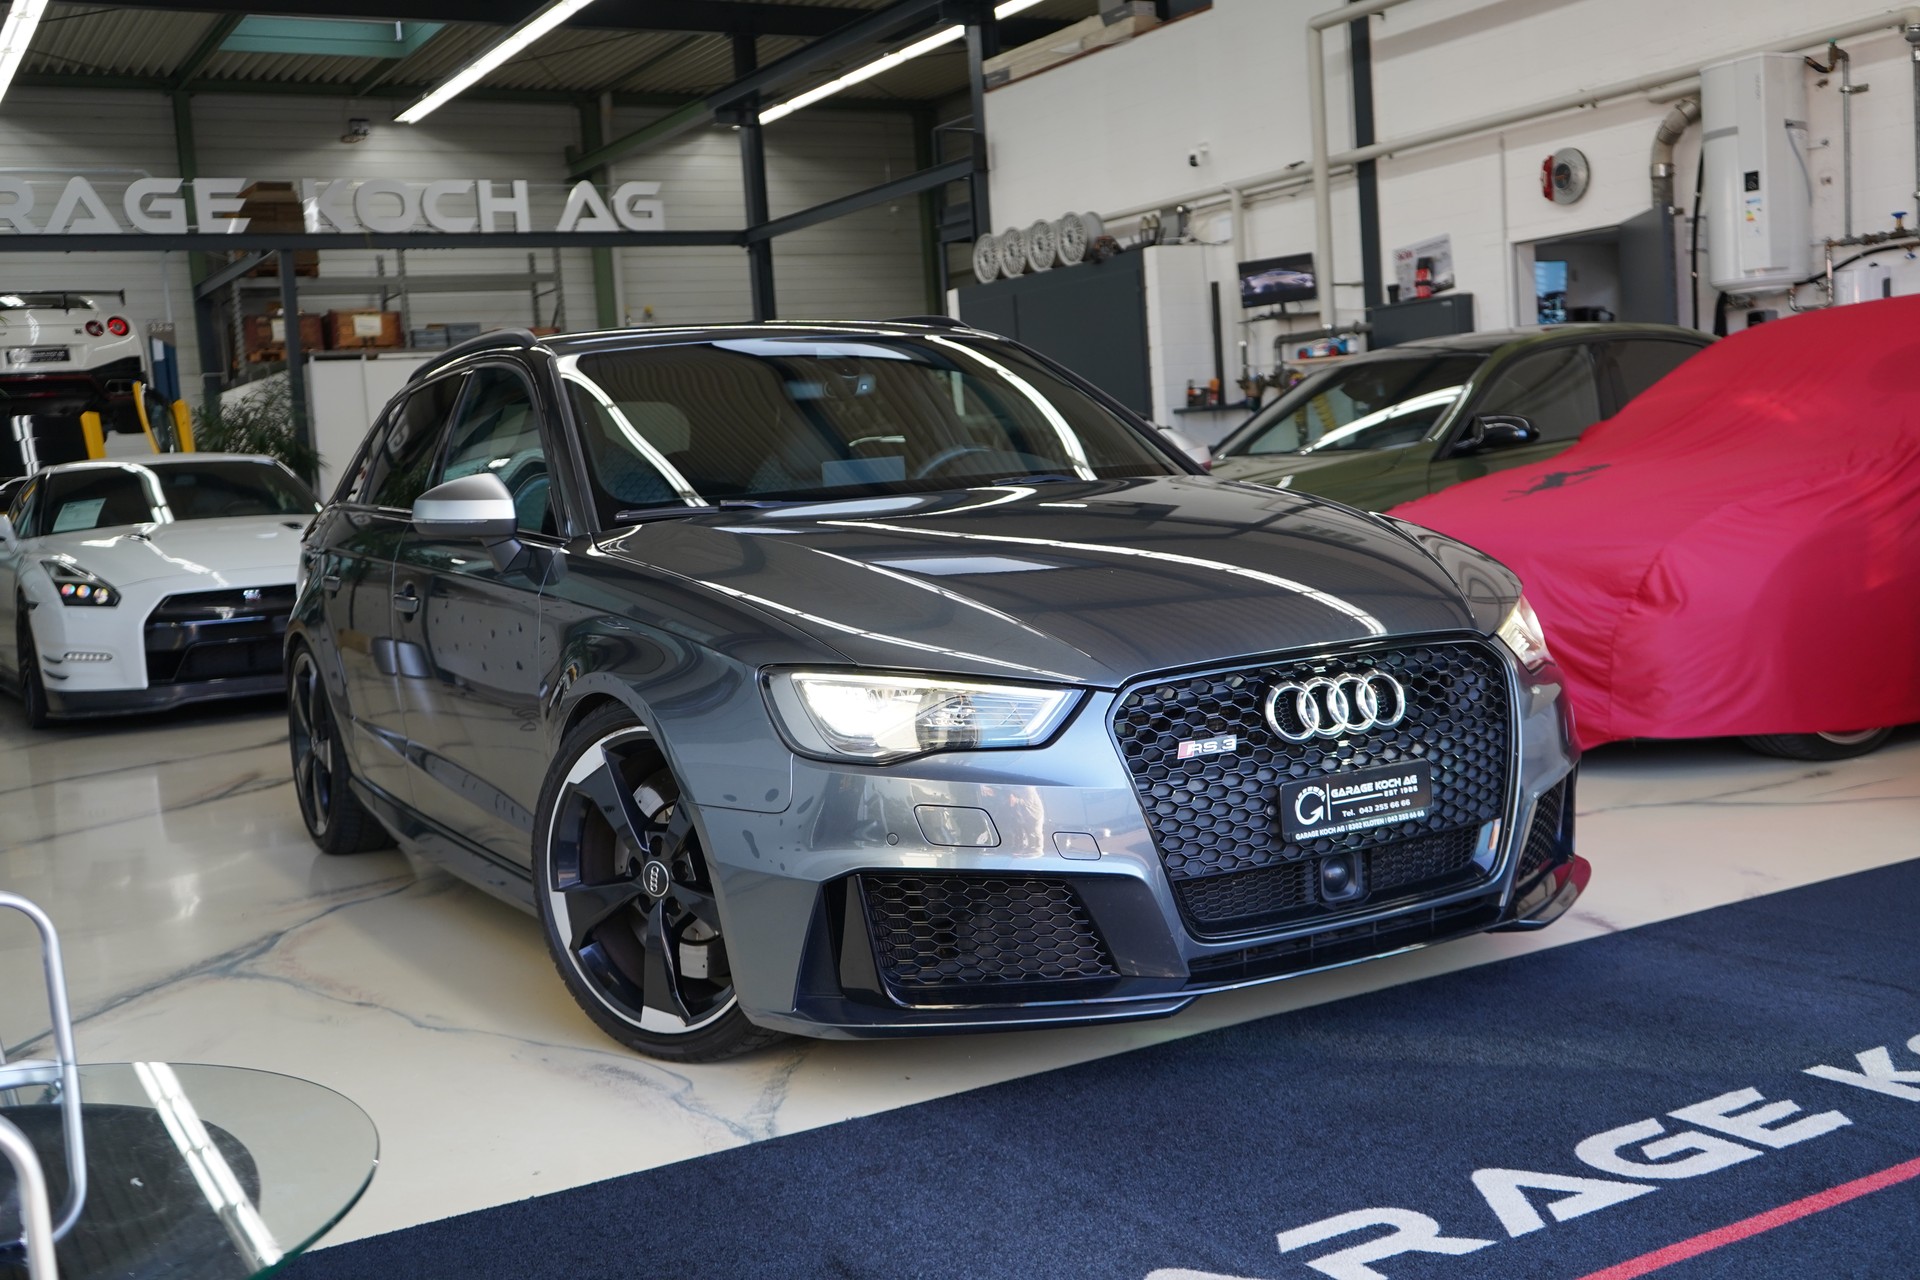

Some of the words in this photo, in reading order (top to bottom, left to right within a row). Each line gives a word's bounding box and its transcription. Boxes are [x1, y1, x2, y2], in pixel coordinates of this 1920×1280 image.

[303, 178, 531, 234] KOCH
[557, 179, 664, 232] AG
[1330, 783, 1374, 798] GARAGE
[1375, 777, 1402, 791] KOCH
[1402, 775, 1418, 786] AG
[1384, 789, 1398, 797] EST
[1342, 809, 1356, 818] Tel.
[1359, 805, 1374, 815] 043
[1389, 800, 1400, 809] 66
[1400, 798, 1411, 807] 66
[1295, 829, 1320, 840] GARAGE
[1320, 826, 1337, 836] KOCH
[1337, 824, 1346, 833] AG
[1362, 818, 1385, 829] KLOTEN
[1387, 815, 1399, 823] 043
[1144, 1086, 1853, 1280] RAGE
[1801, 1032, 1920, 1103] K
